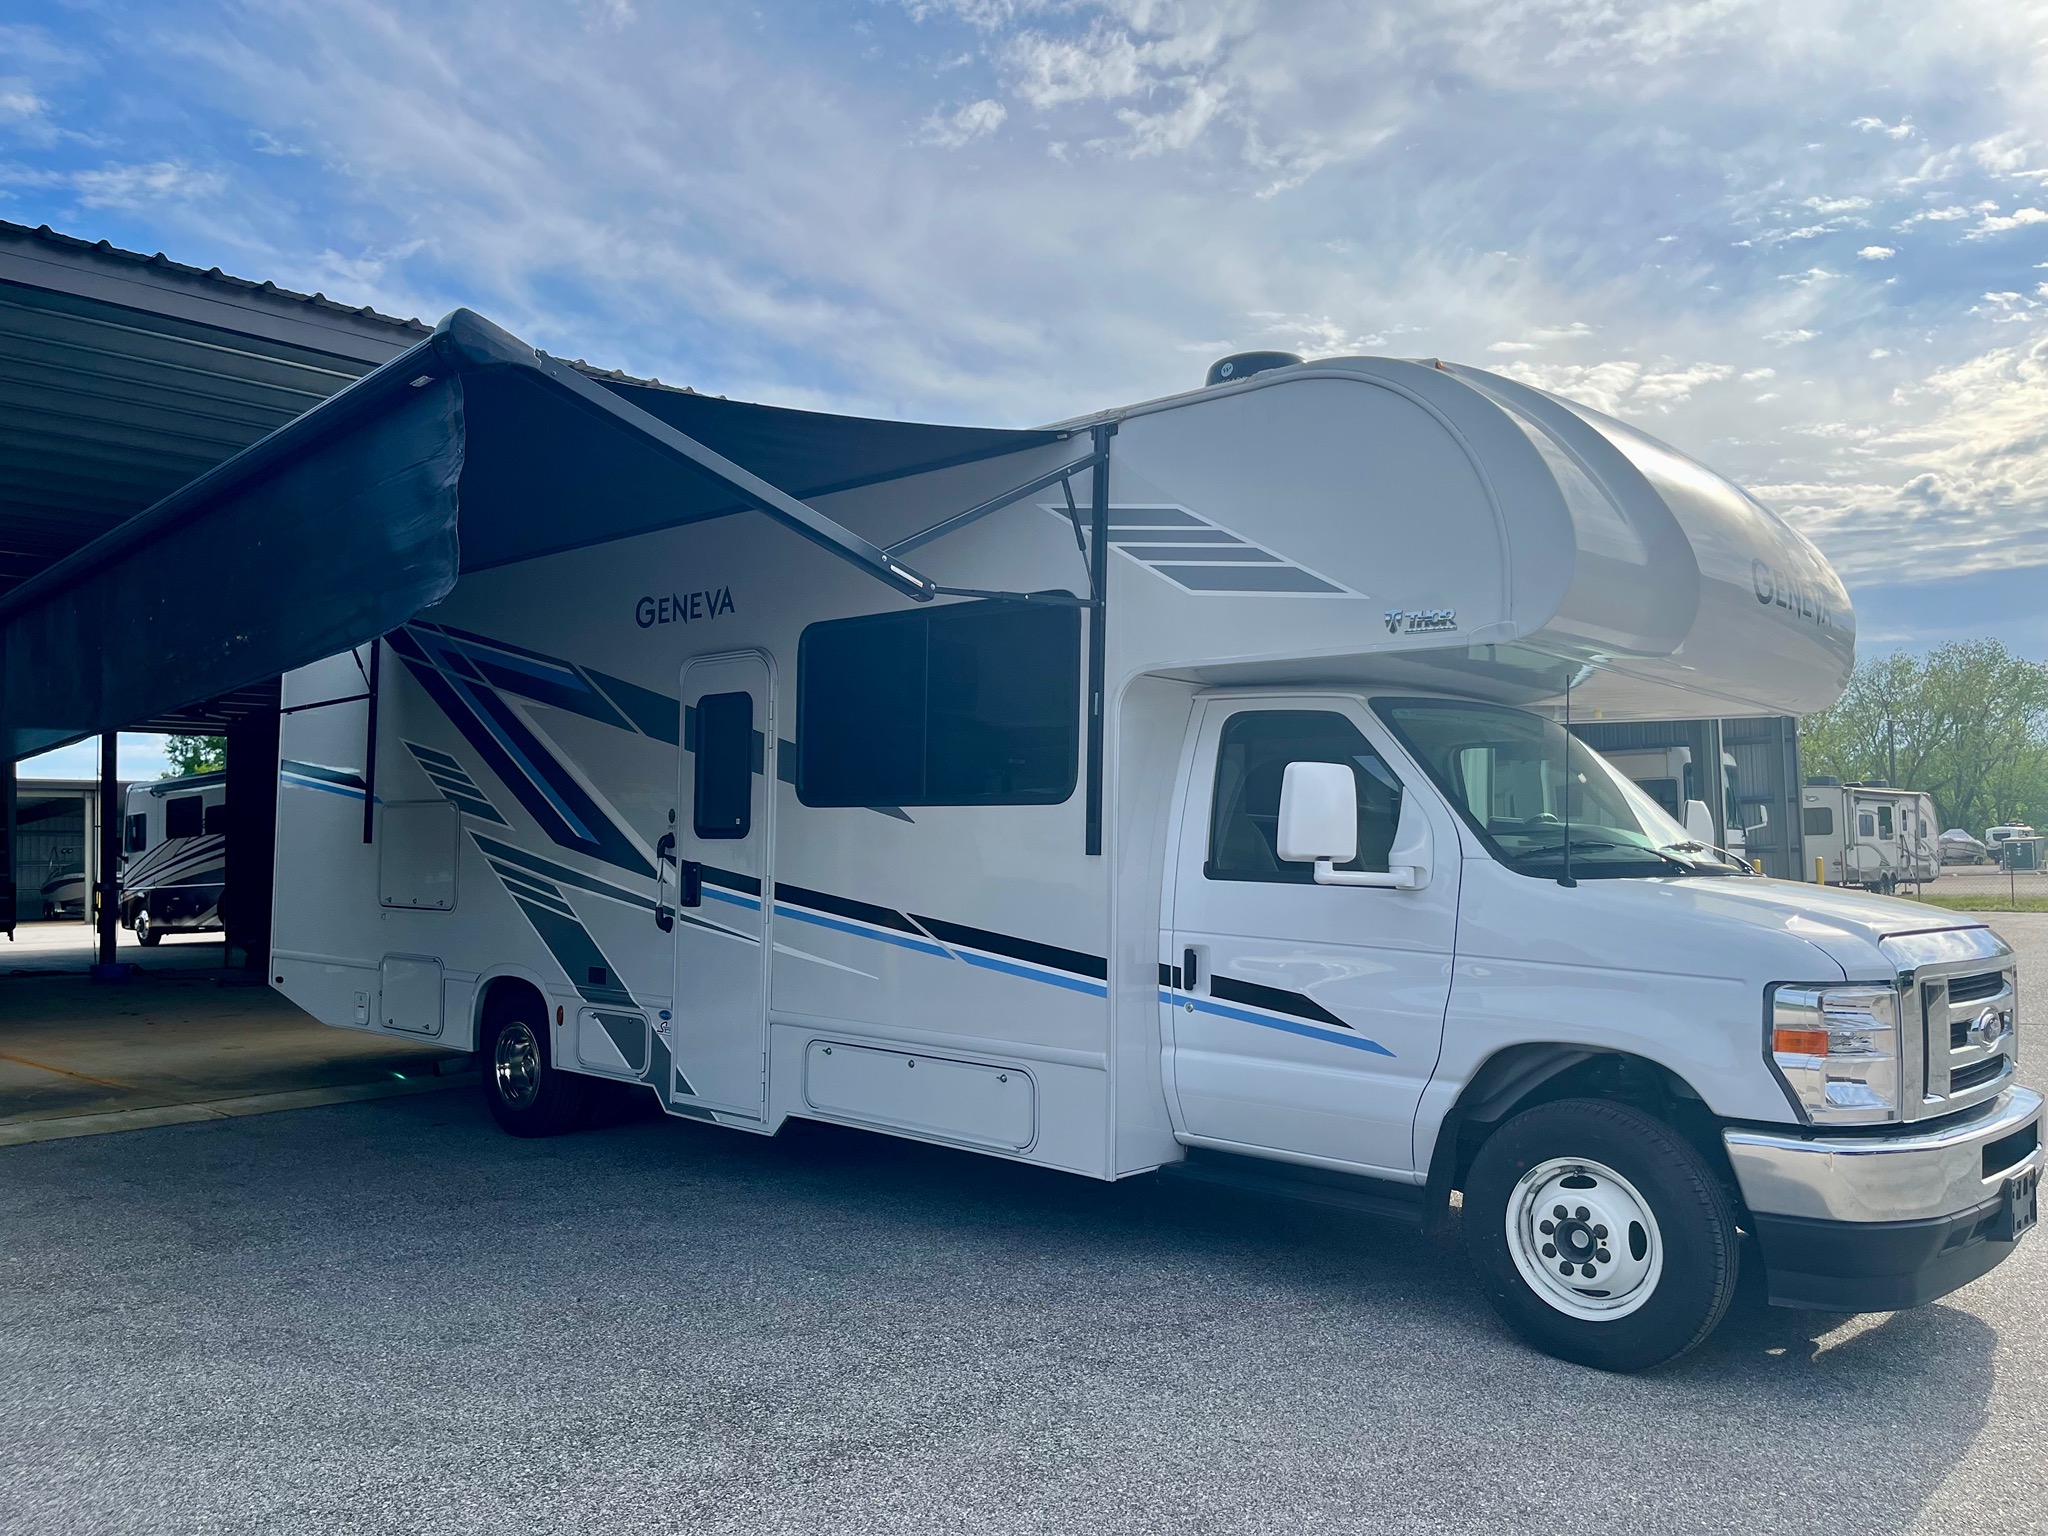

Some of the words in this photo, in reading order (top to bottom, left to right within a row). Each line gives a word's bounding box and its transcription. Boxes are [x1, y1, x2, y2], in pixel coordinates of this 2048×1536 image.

[635, 585, 735, 628] GENEVA
[1751, 557, 1832, 627] GENEVA
[1404, 608, 1457, 630] THOR
